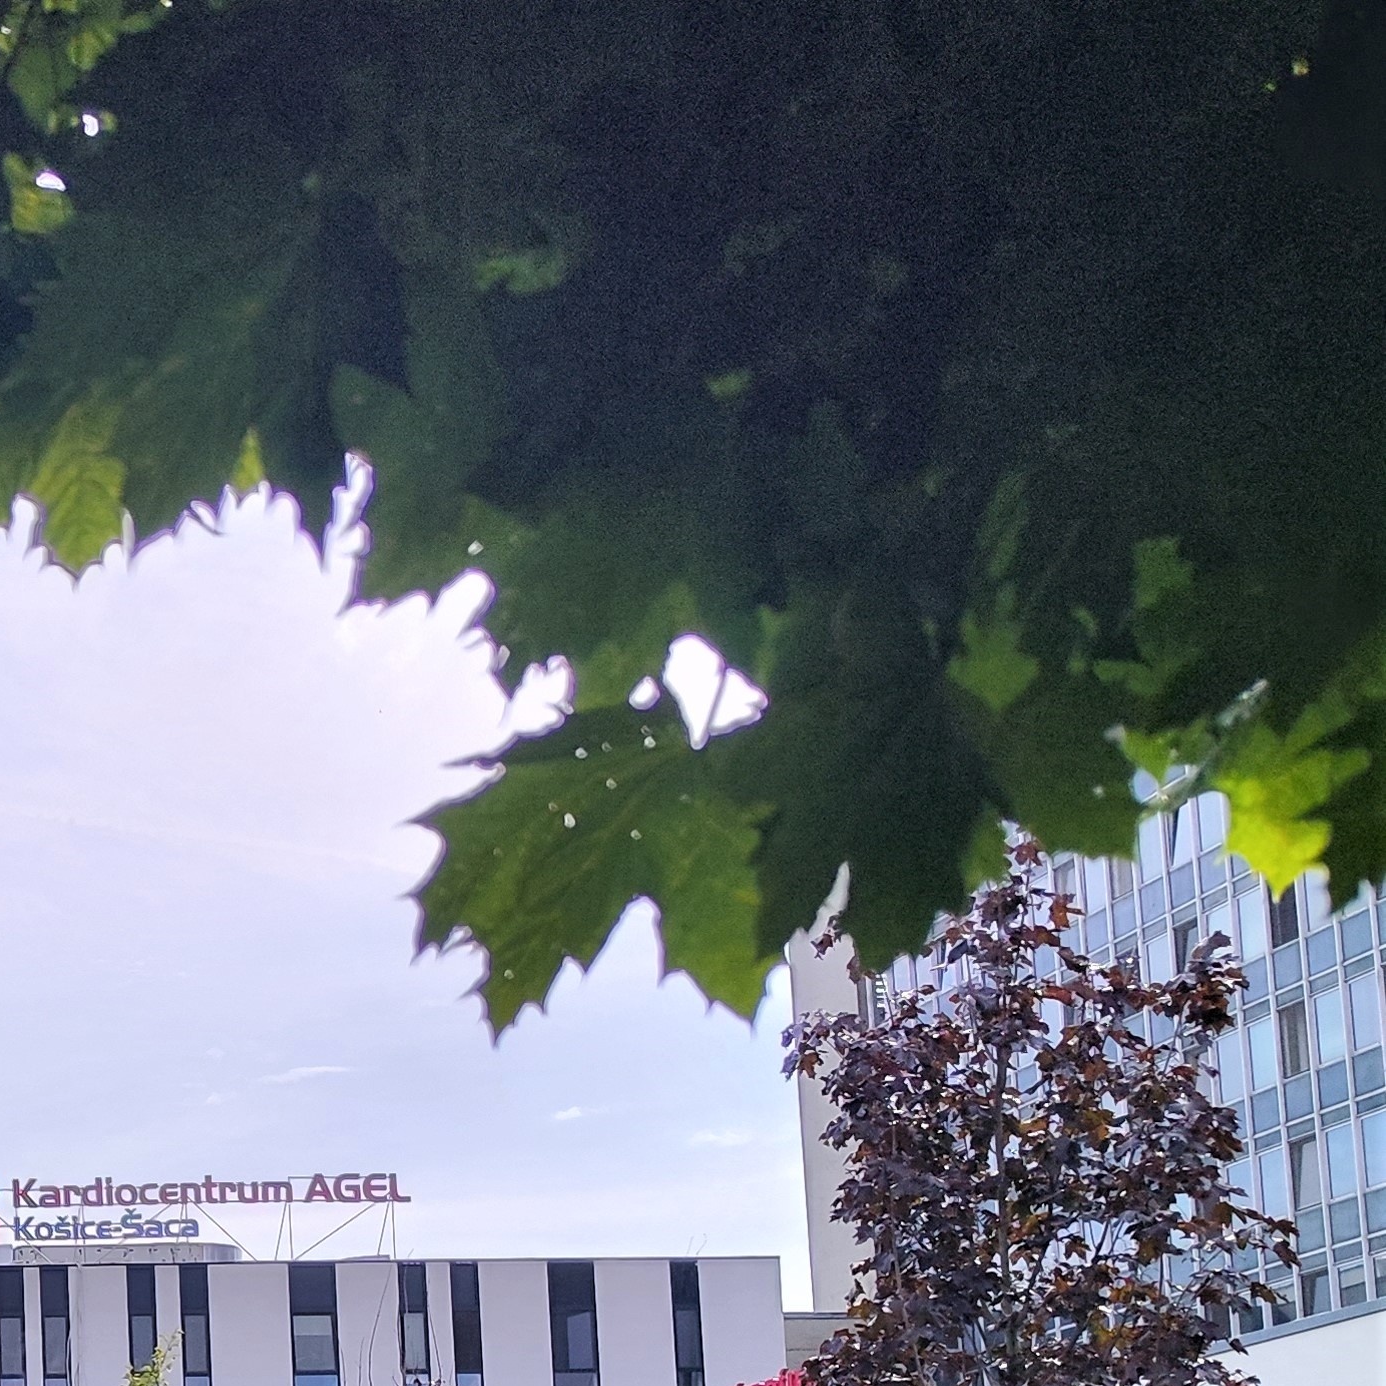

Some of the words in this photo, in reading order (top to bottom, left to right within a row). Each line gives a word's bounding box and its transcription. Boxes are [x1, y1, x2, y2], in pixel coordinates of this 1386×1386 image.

[12, 1175, 293, 1208] Kardiocentrum
[304, 1173, 411, 1203] AGEL
[13, 1208, 200, 1241] Košice-Šaca
